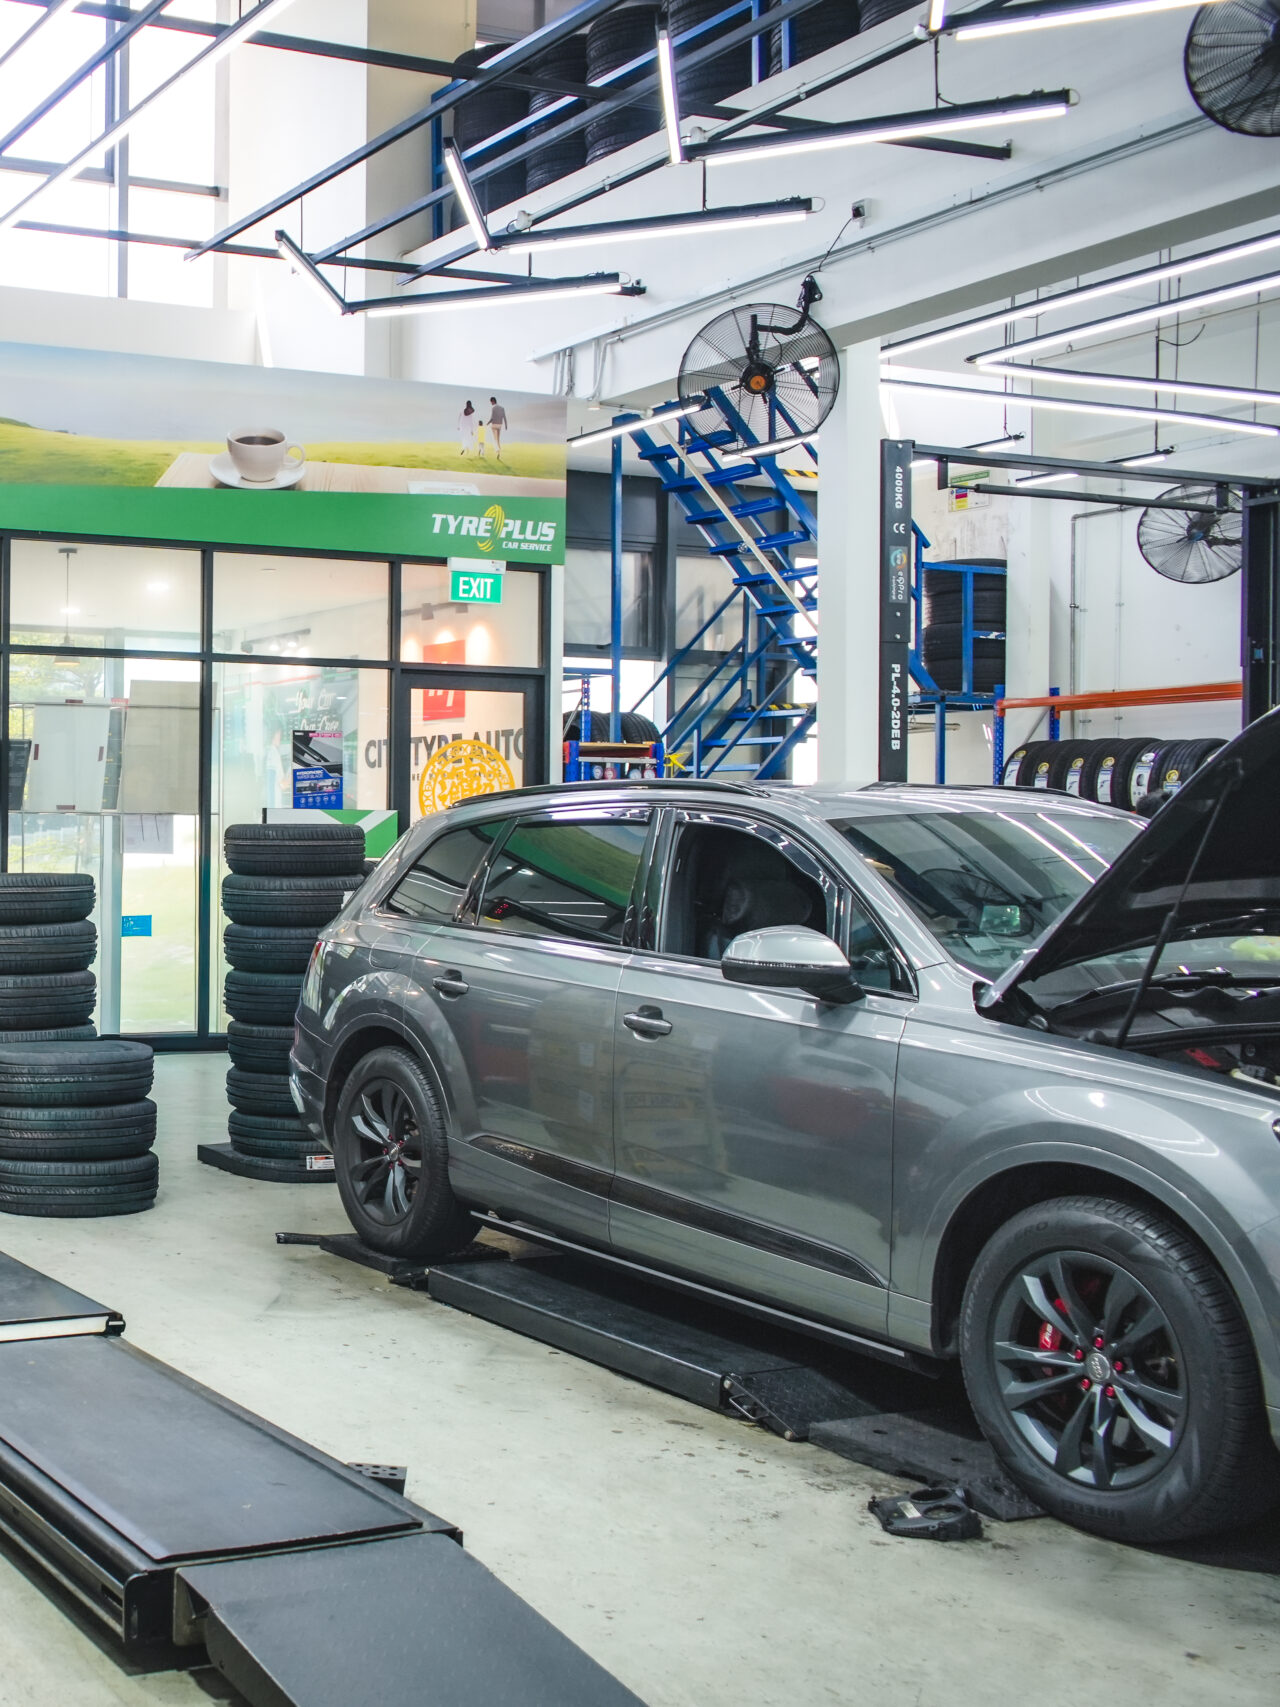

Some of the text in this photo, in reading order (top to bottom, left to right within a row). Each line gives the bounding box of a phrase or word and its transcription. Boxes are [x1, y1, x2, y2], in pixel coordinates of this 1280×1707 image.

[895, 466, 904, 509] 4000KG
[502, 541, 552, 552] CAR SERVICE
[459, 577, 494, 599] EXIT
[364, 738, 388, 769] CIT
